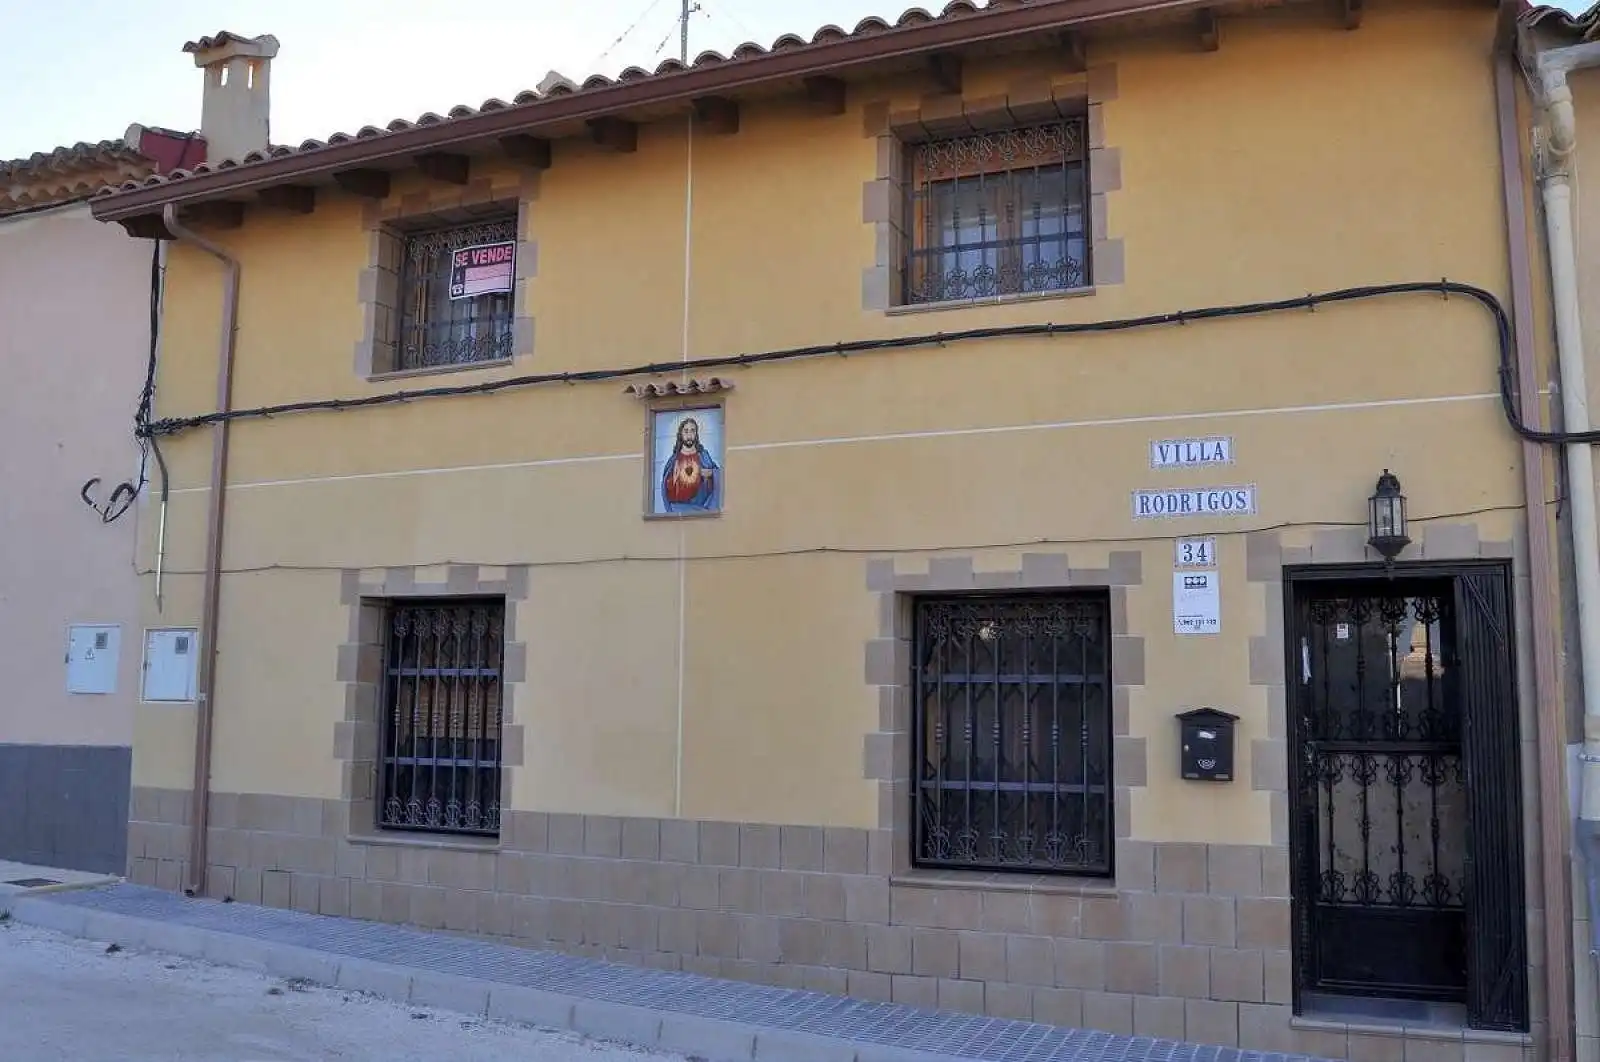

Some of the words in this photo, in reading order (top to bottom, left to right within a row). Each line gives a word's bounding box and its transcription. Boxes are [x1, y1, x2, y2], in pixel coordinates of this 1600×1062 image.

[455, 251, 469, 268] SE
[471, 246, 512, 265] VENDE
[1158, 441, 1225, 463] VILLA
[1139, 491, 1247, 514] RODRIGOS
[1183, 543, 1207, 562] 34
